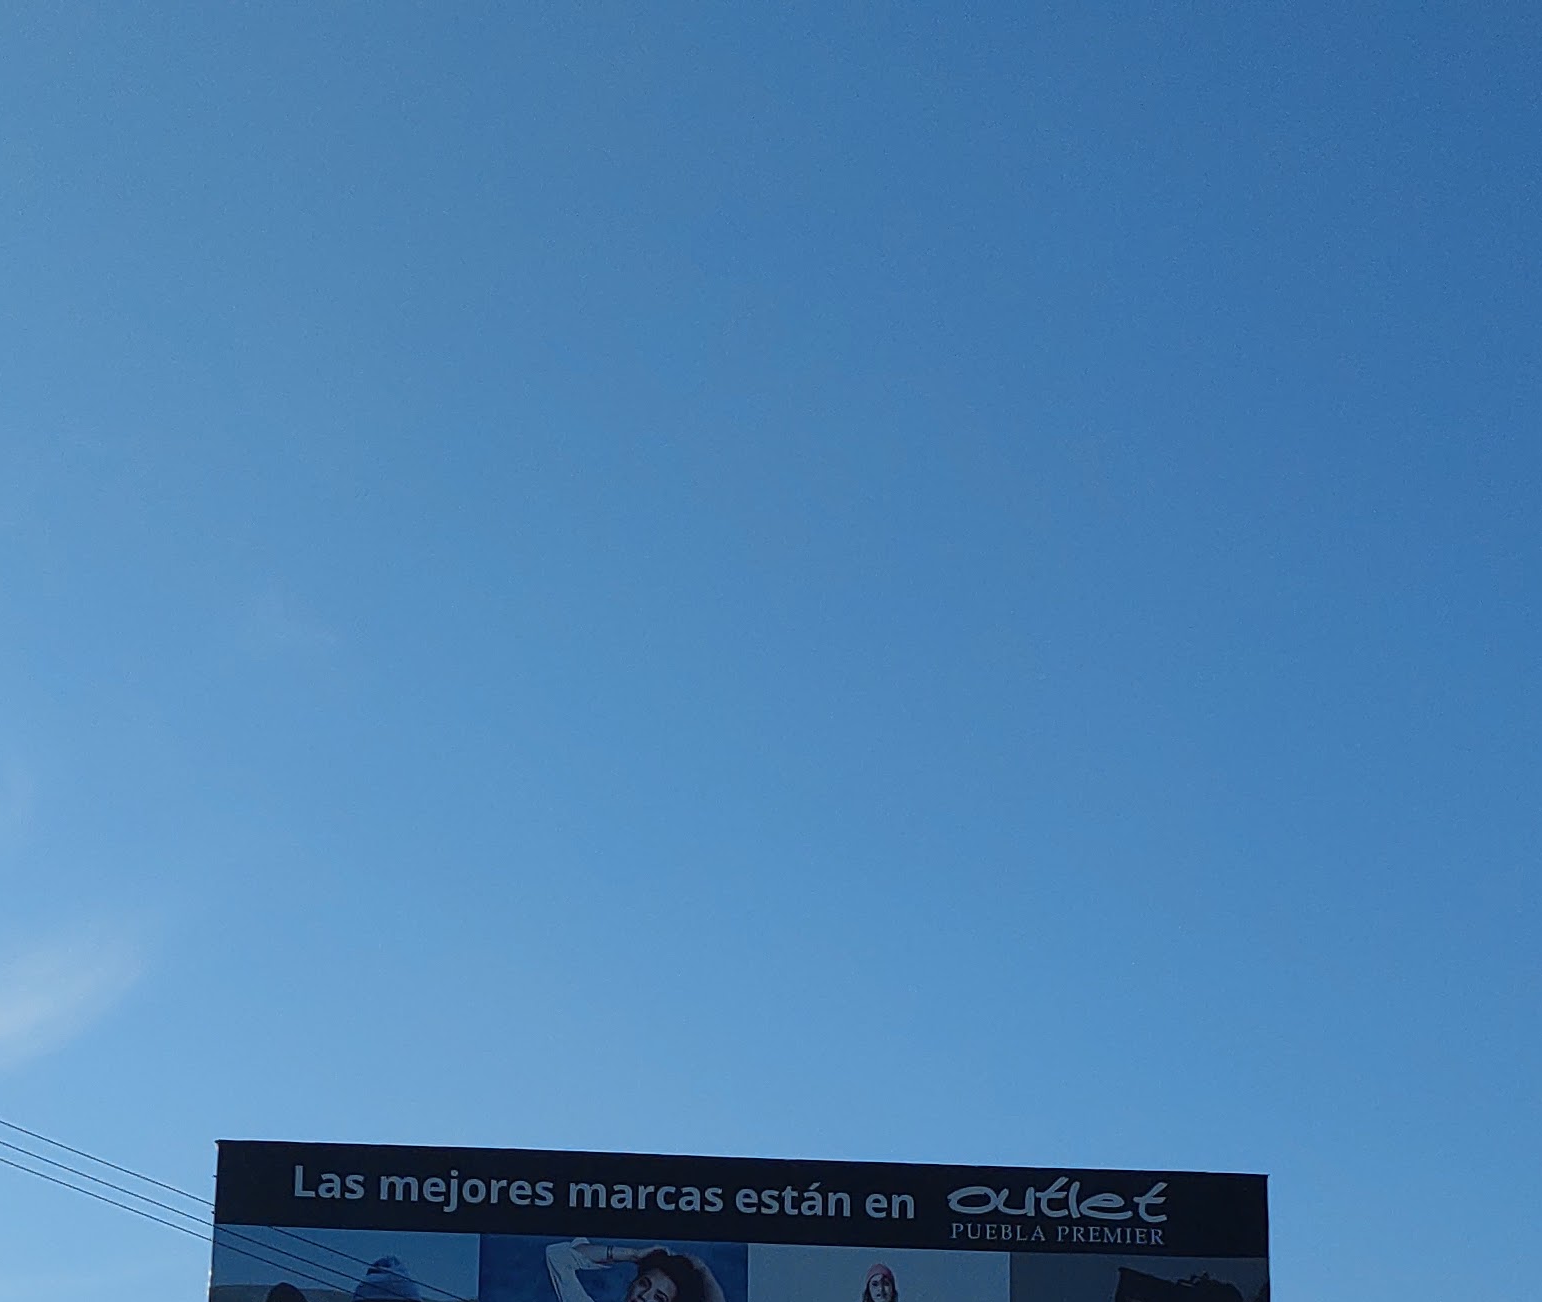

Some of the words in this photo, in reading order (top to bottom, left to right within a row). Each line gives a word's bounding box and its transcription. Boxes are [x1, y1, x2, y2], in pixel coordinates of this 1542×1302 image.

[293, 1164, 365, 1200] Las
[379, 1169, 554, 1213] mejores
[568, 1181, 724, 1213] marcas
[735, 1181, 852, 1218] están
[864, 1192, 916, 1220] en
[946, 1175, 1168, 1223] outlet
[950, 1222, 1047, 1242] PUEBLA
[1055, 1225, 1166, 1246] PREMIER
